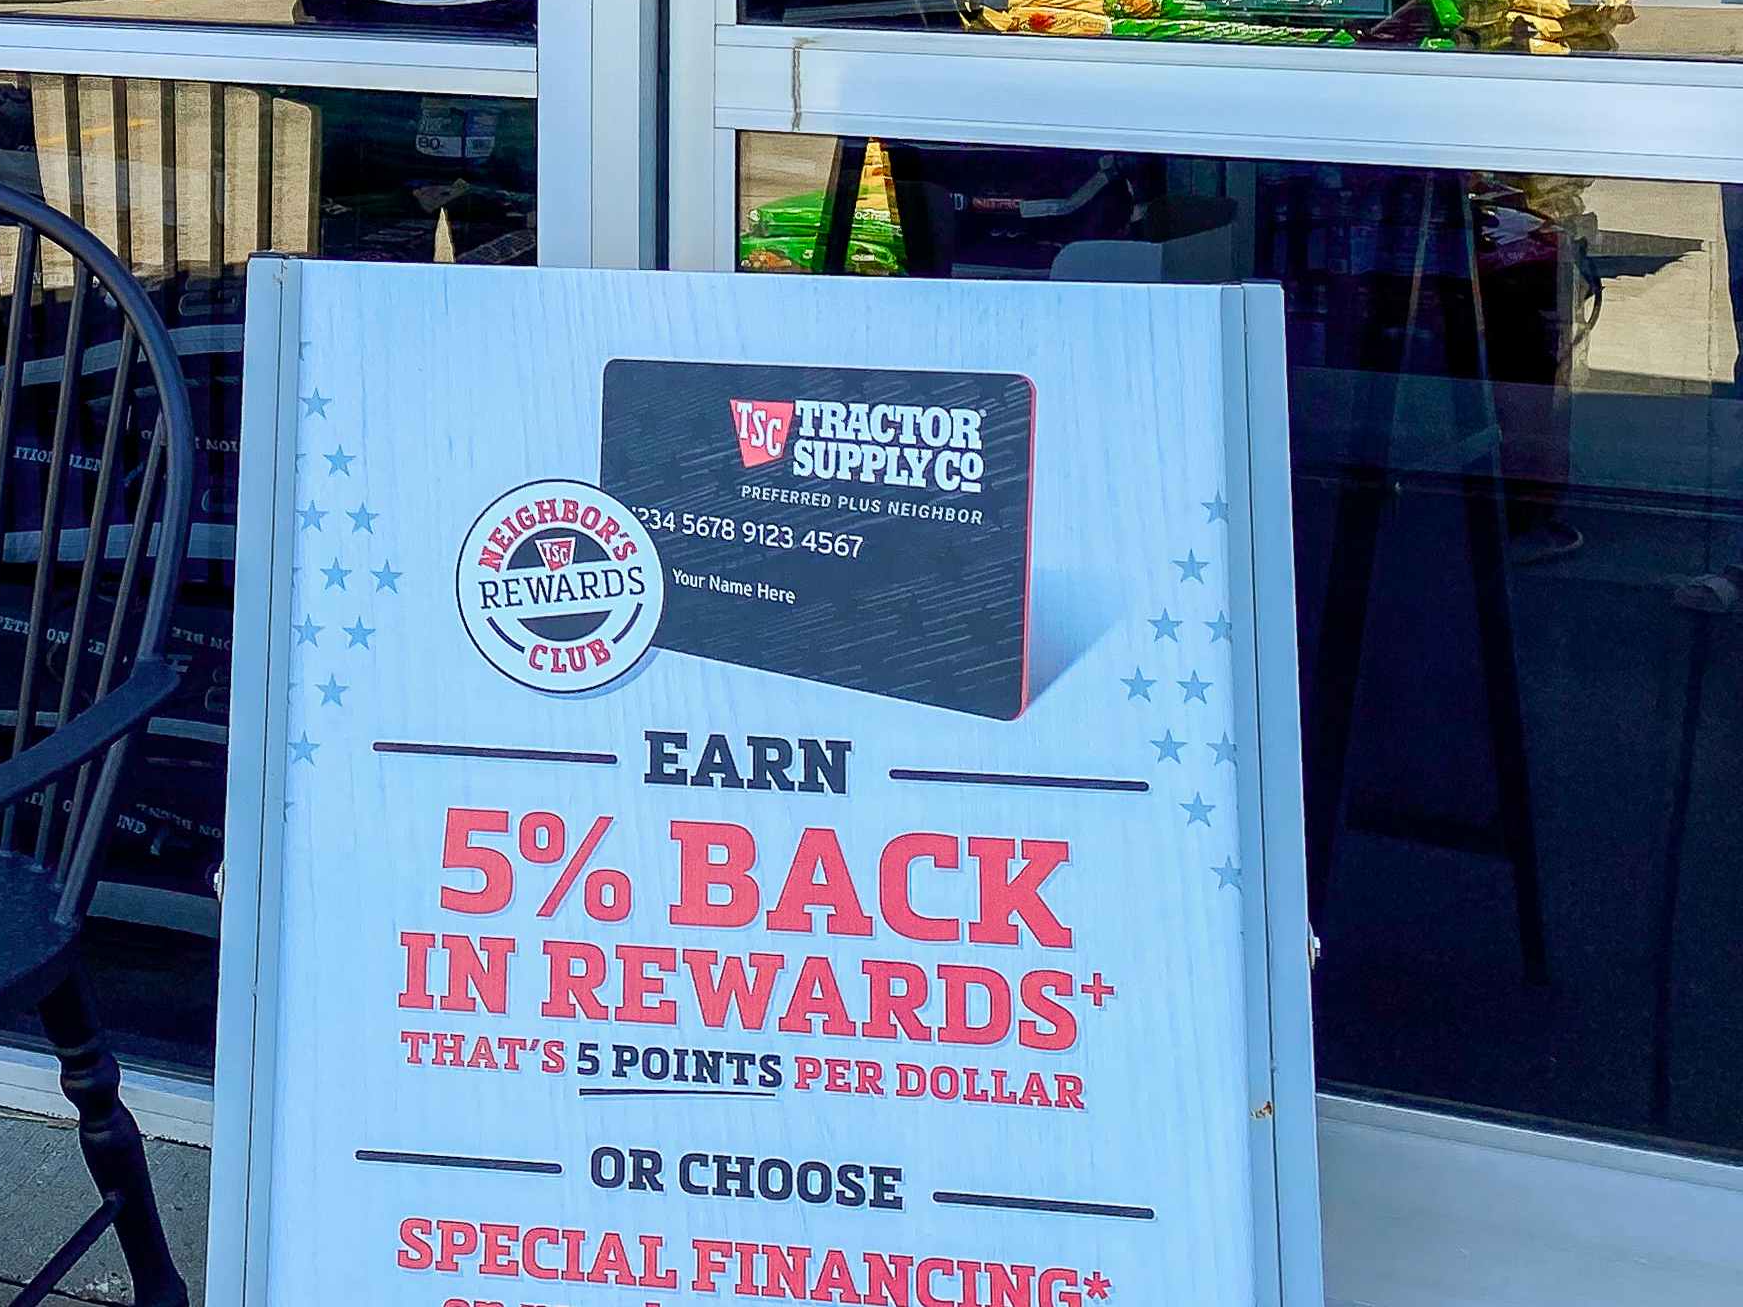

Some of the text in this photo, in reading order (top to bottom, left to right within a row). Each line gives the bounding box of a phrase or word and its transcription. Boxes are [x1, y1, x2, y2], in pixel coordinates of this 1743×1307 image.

[737, 399, 983, 458] TSC TRACTOR
[791, 445, 932, 489] SUPPLY
[741, 484, 985, 527] PREFERRED PLUS NEIGHBOR
[477, 498, 638, 574] NEIGHBOR'S
[541, 540, 572, 567] TSC
[681, 513, 737, 542] 5678
[741, 521, 795, 550] 9123
[800, 529, 865, 559] 4567
[477, 565, 648, 612] REWARDS
[671, 567, 797, 606] Your Name Here
[528, 636, 613, 675] CLUB
[643, 729, 853, 796] EARN
[439, 806, 1074, 950] 5% BACK
[397, 931, 516, 1015] IN
[400, 1029, 1086, 1111] THAT'S 5 POINTS PER DOLLAR
[589, 1145, 905, 1213] OR CHOOSE
[397, 1217, 679, 1289] SPECIAL
